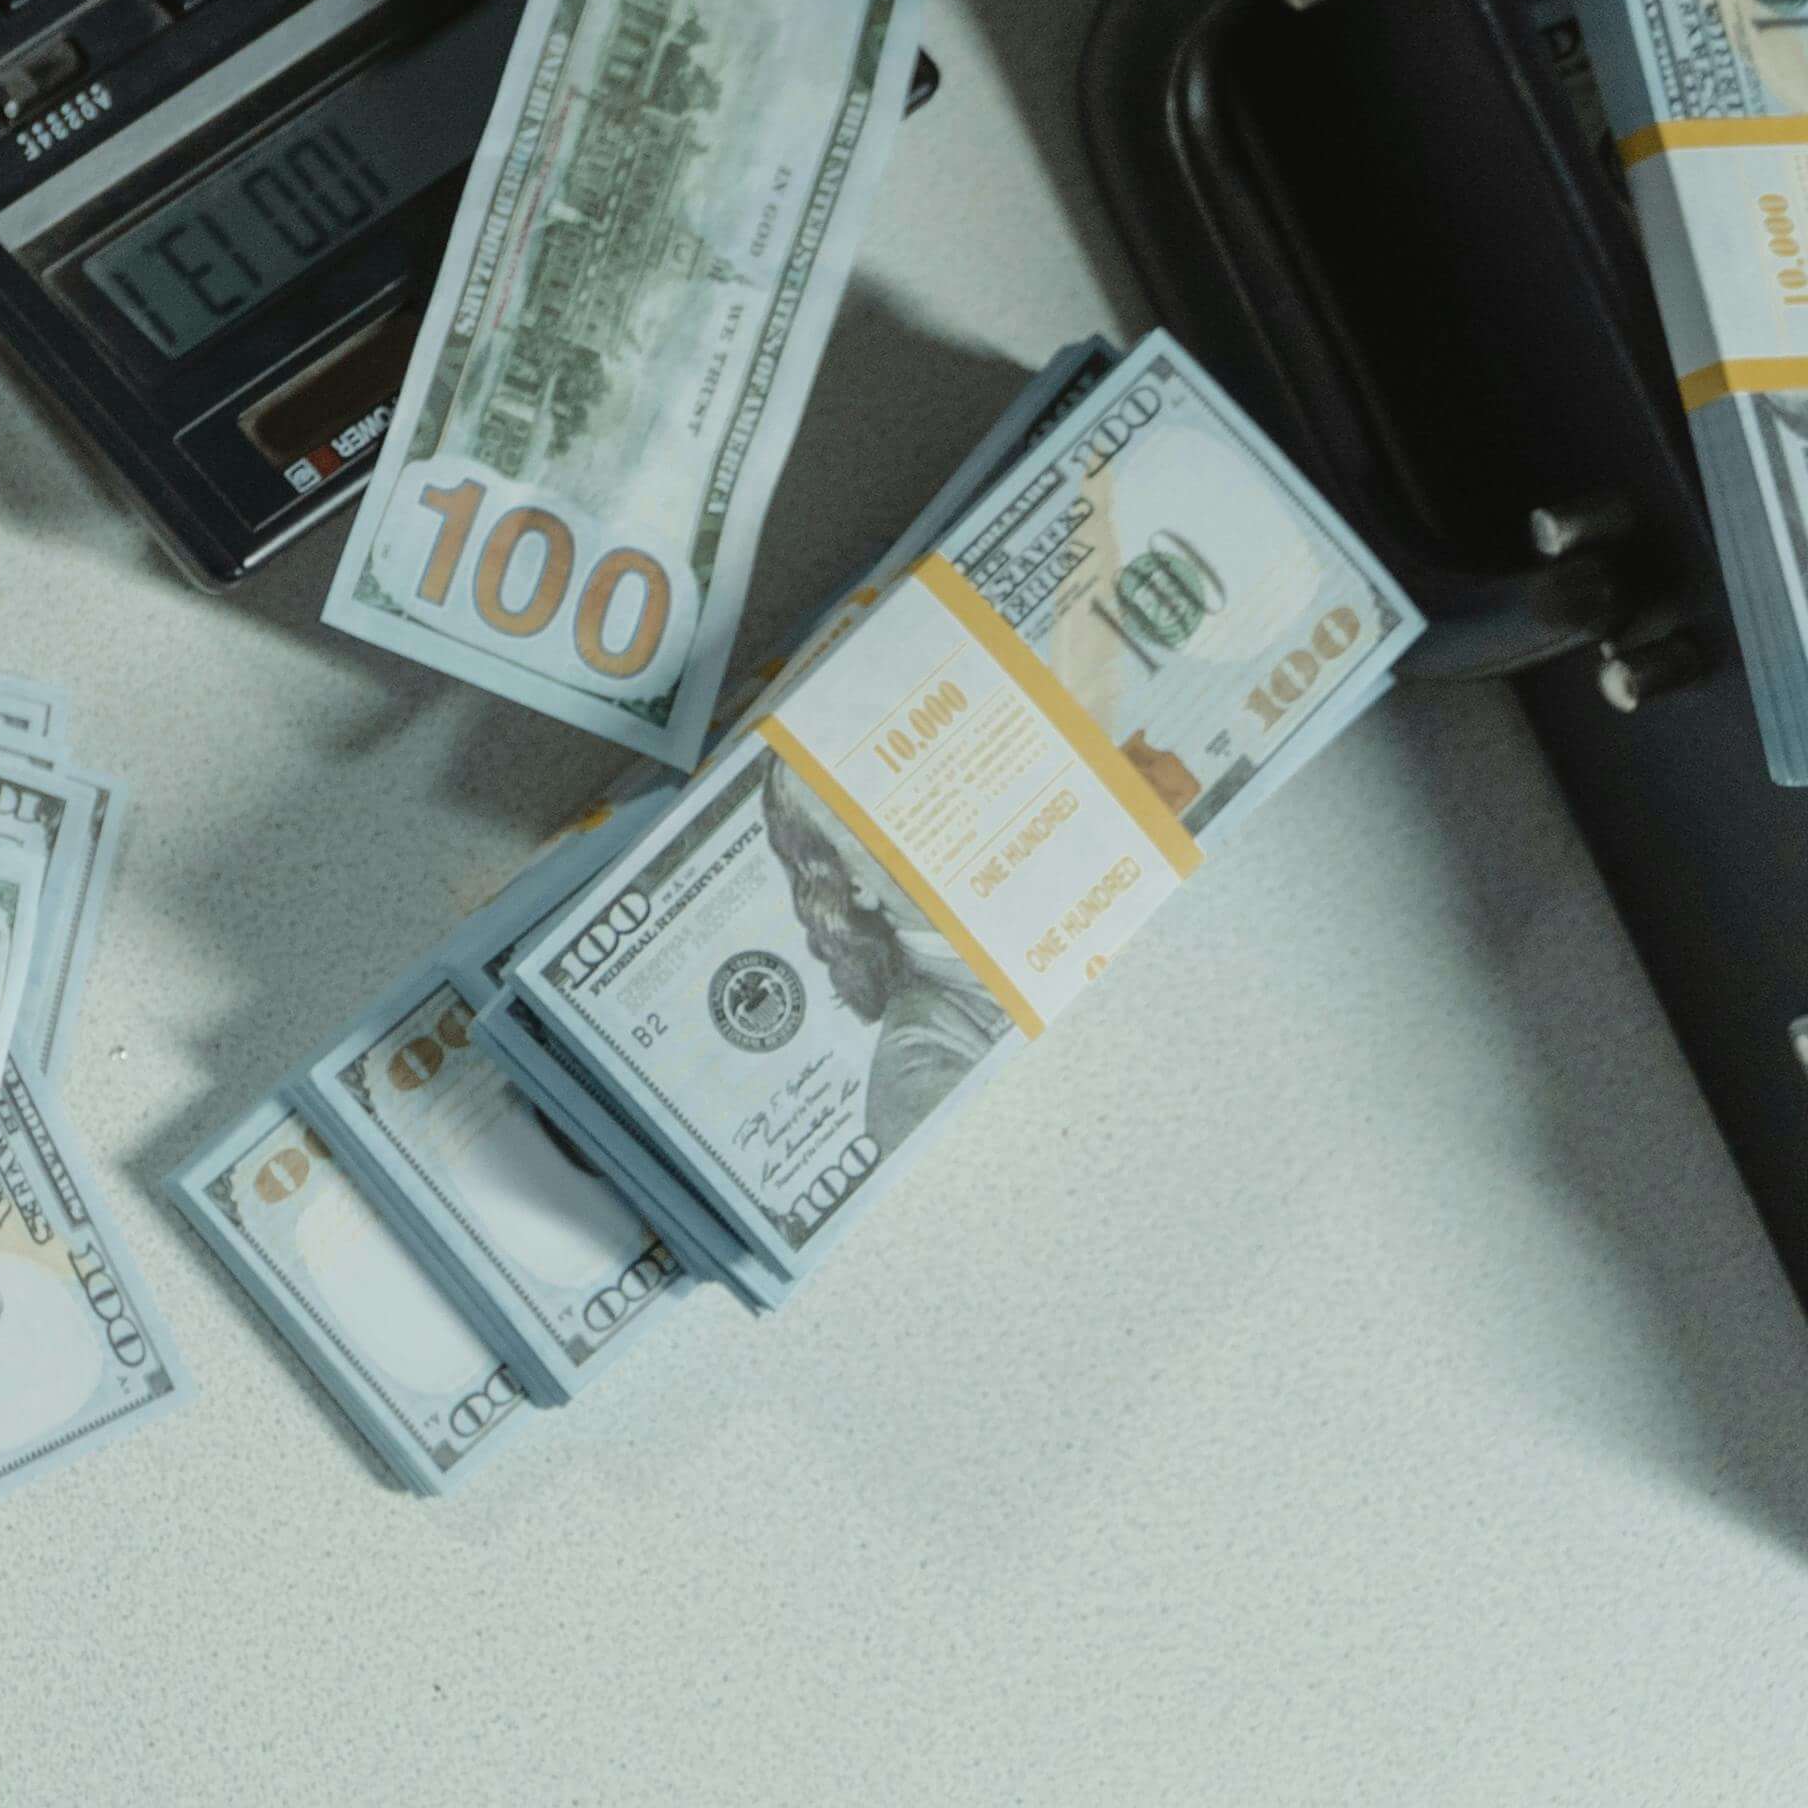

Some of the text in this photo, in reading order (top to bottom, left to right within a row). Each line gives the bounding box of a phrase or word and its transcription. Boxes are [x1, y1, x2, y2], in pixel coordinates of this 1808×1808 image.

[1063, 378, 1172, 479] 100
[429, 485, 669, 668] 100
[1236, 599, 1371, 733] 100
[554, 882, 658, 993] 100
[628, 1009, 670, 1051] B2
[785, 1126, 885, 1236] 100
[62, 1238, 156, 1371] 100
